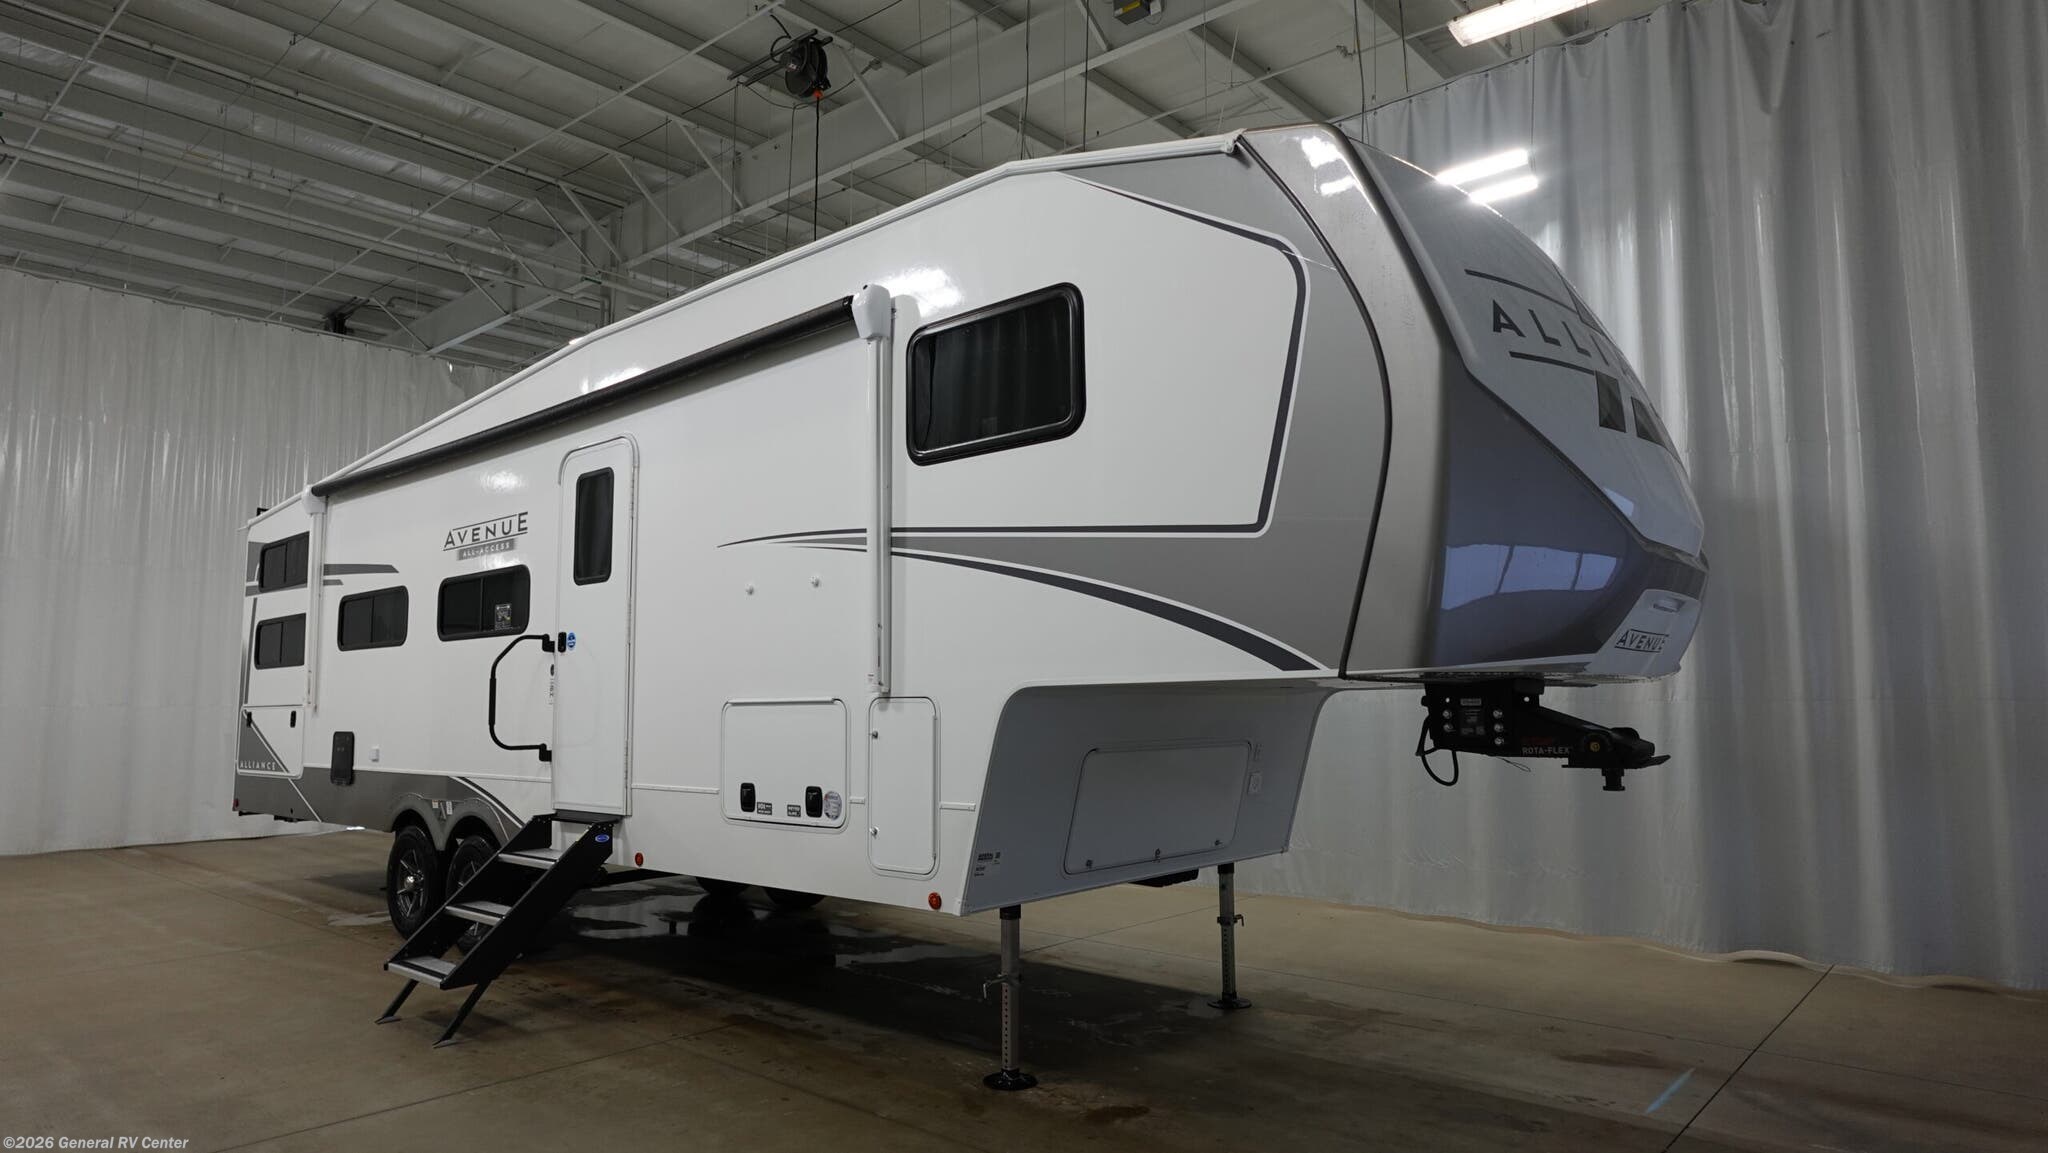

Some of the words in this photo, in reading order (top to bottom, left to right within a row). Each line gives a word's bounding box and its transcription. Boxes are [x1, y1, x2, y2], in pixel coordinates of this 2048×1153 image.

[444, 511, 528, 548] AVENUE
[462, 541, 511, 558] ALL-ACCESS
[240, 760, 276, 771] ALLIANCE
